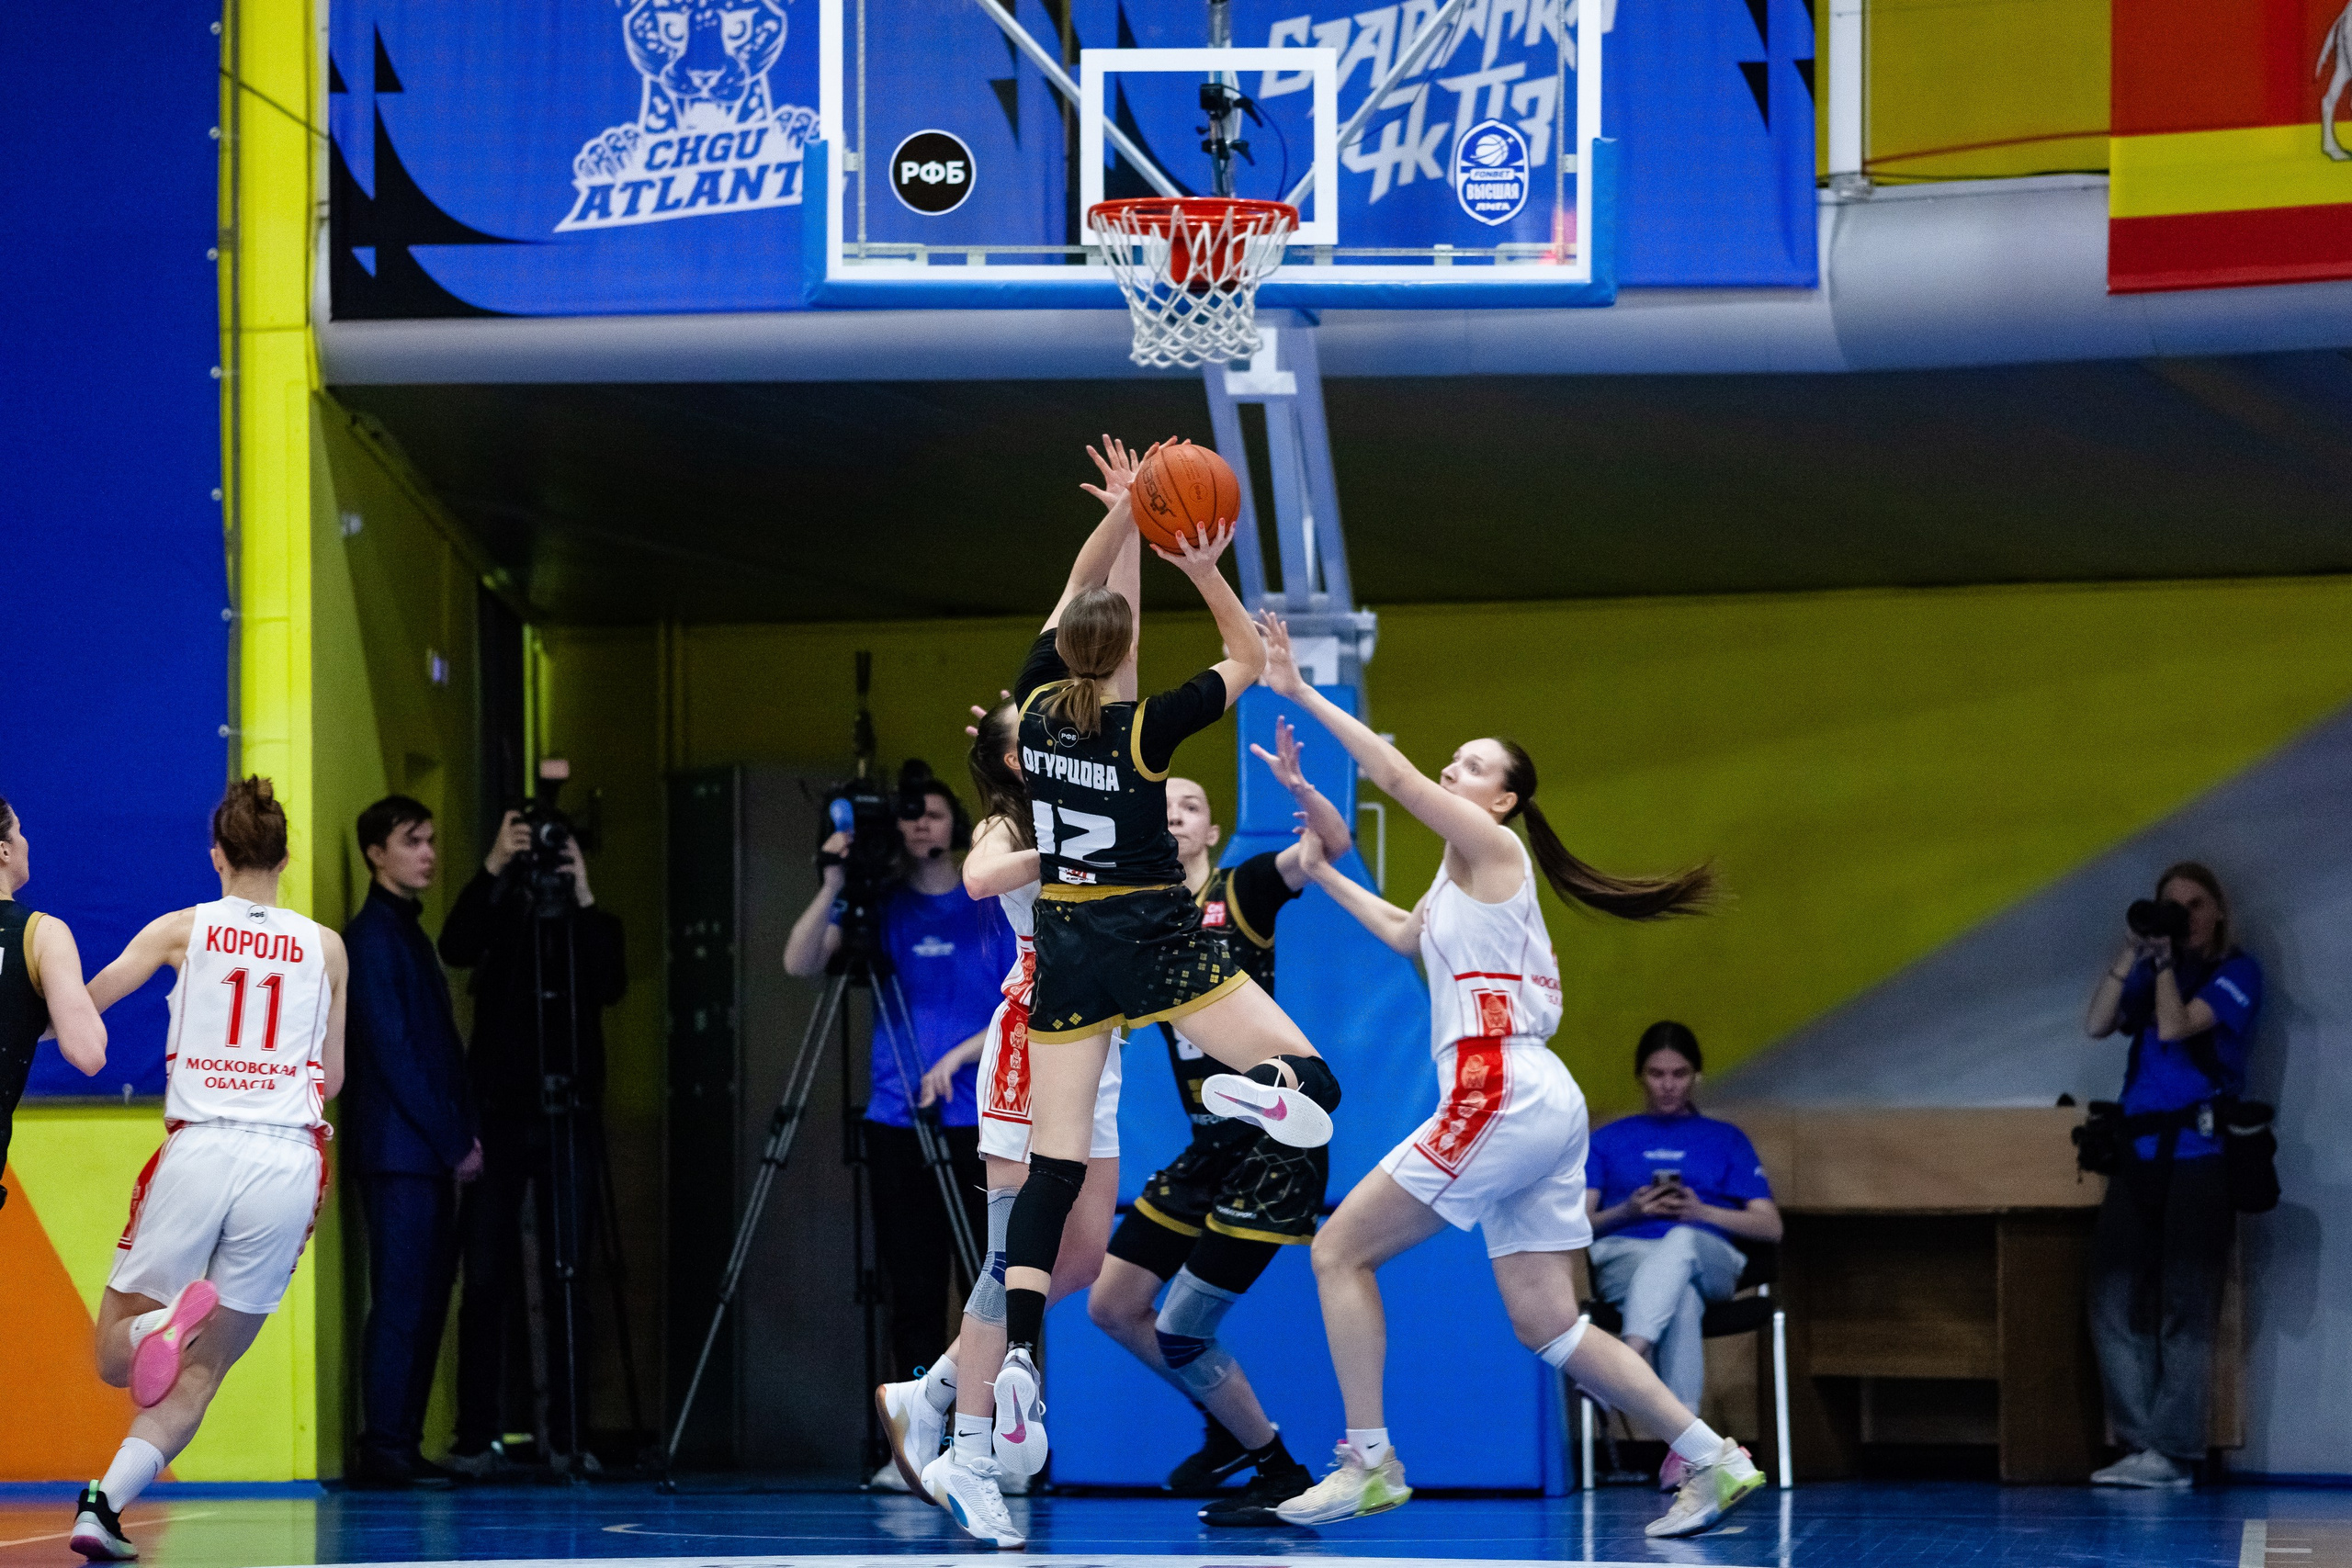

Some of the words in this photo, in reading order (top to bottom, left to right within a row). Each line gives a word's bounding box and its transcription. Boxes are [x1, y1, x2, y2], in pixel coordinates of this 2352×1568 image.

[644, 127, 769, 172] CHGU
[572, 161, 803, 222] ATLANT
[900, 160, 966, 185] РФБ
[1466, 183, 1520, 200] ВЫСШАЯ
[1475, 202, 1511, 211] ЛИГА
[1023, 745, 1120, 792] ОГУРЦОВА
[1031, 799, 1117, 868] 12
[206, 925, 304, 964] КОРОЛЬ
[220, 967, 284, 1051] 11
[186, 1057, 297, 1077] МОСКОВСКАЯ
[205, 1076, 276, 1091] ОБЛАСТЬ
